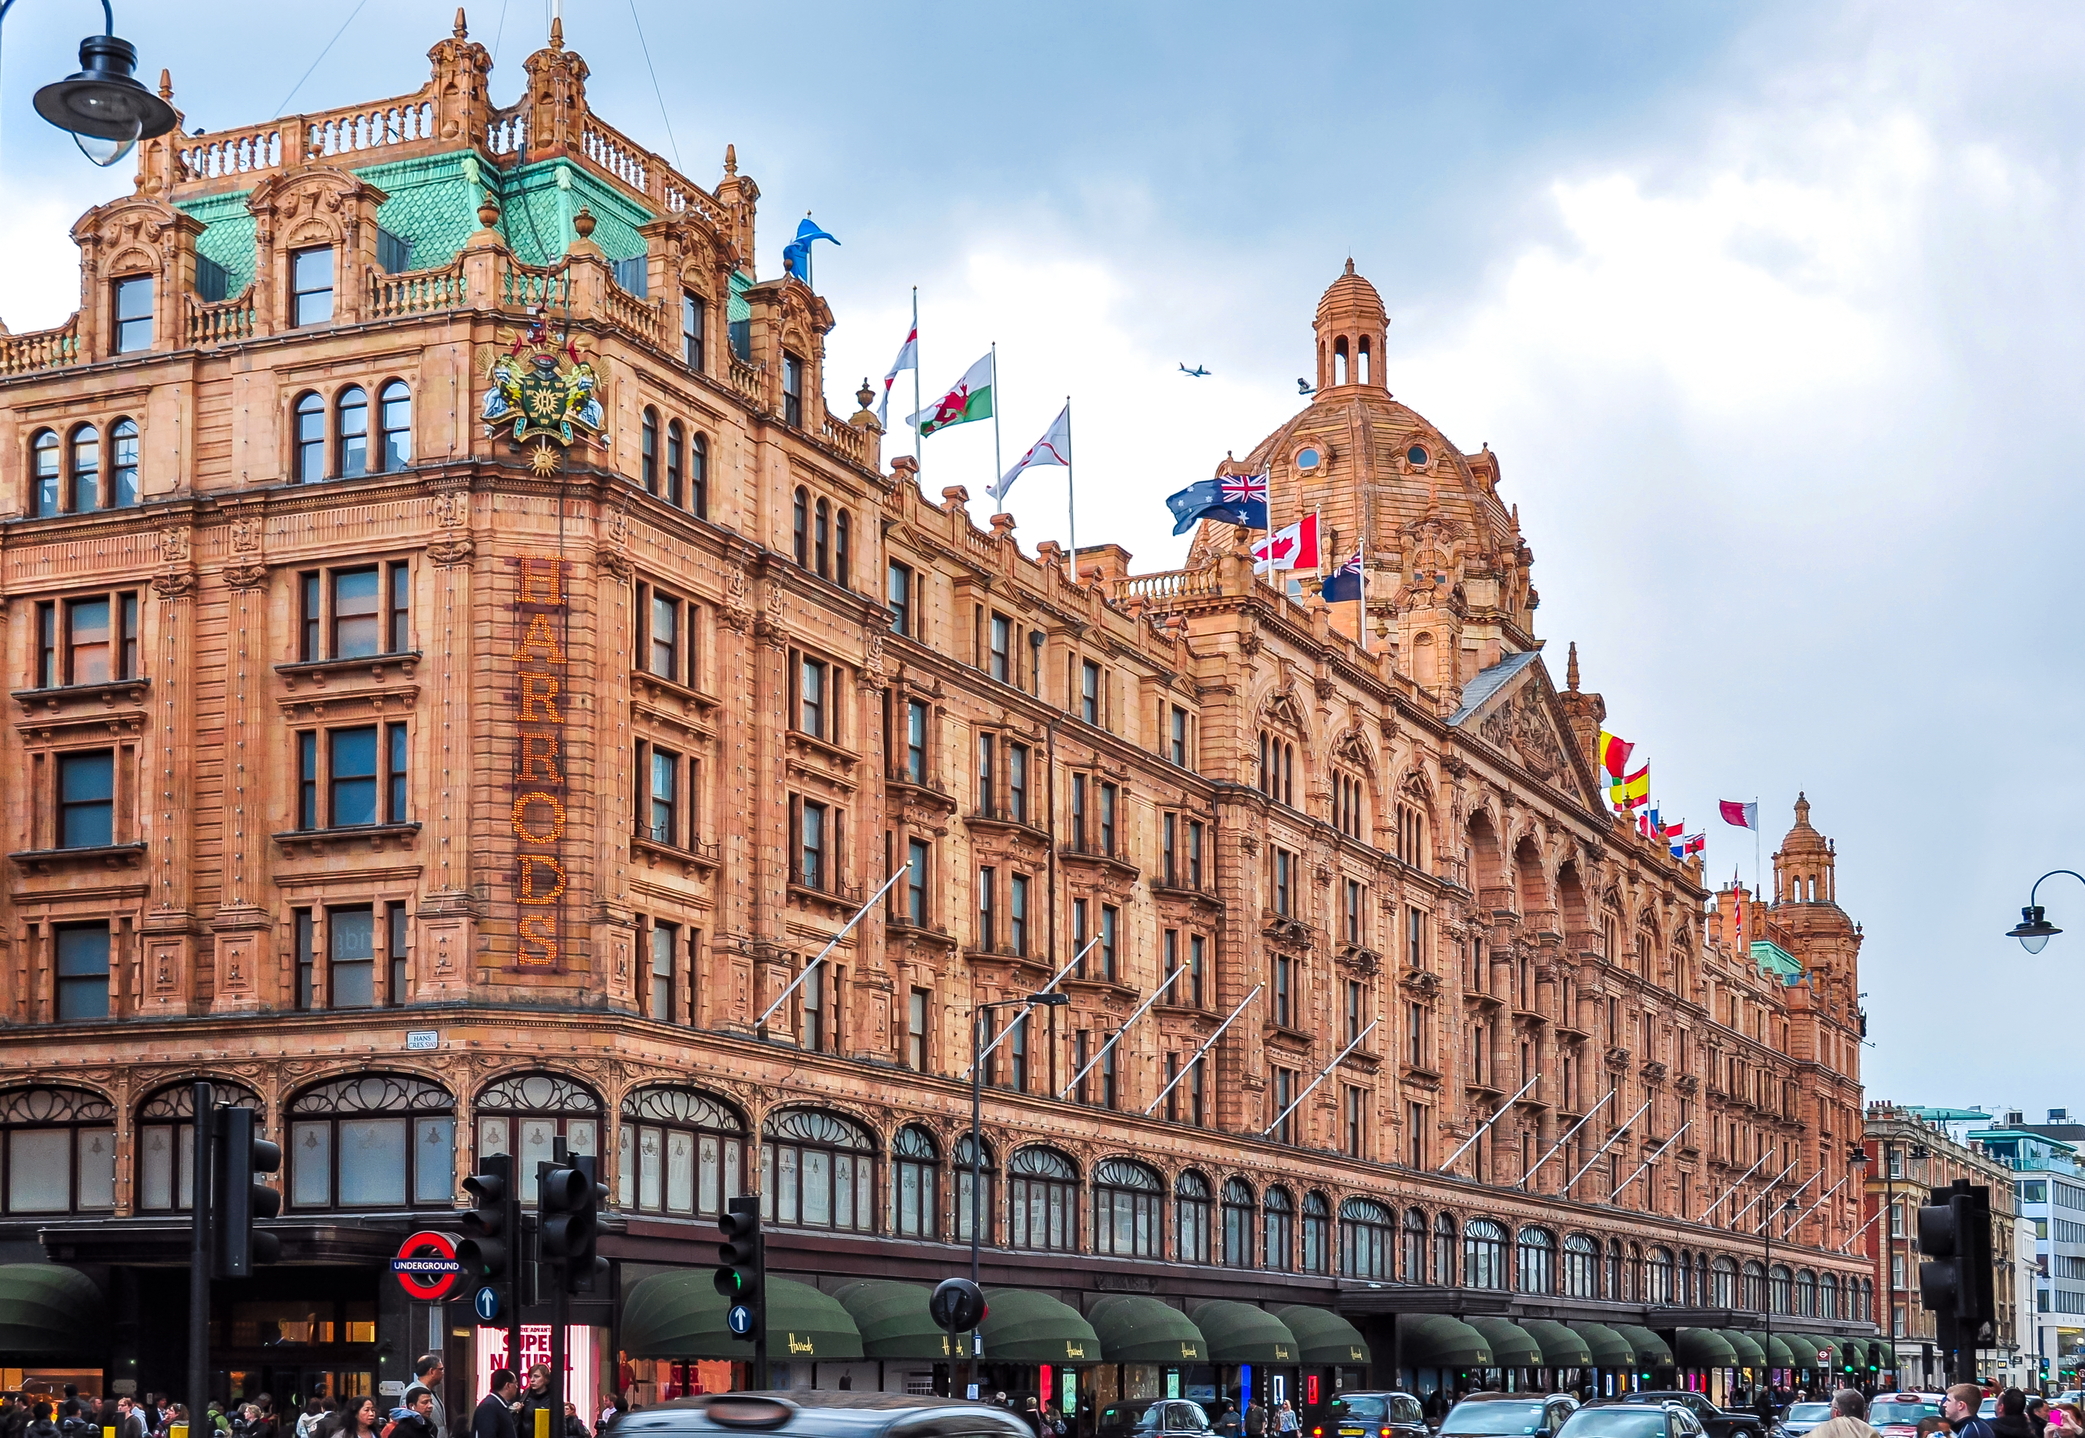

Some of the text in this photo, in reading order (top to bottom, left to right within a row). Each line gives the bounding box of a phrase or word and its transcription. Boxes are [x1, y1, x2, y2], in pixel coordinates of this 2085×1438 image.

[510, 552, 567, 966] HARRODS
[394, 1261, 460, 1270] UNDERGROUND
[788, 1332, 814, 1355] Harrods
